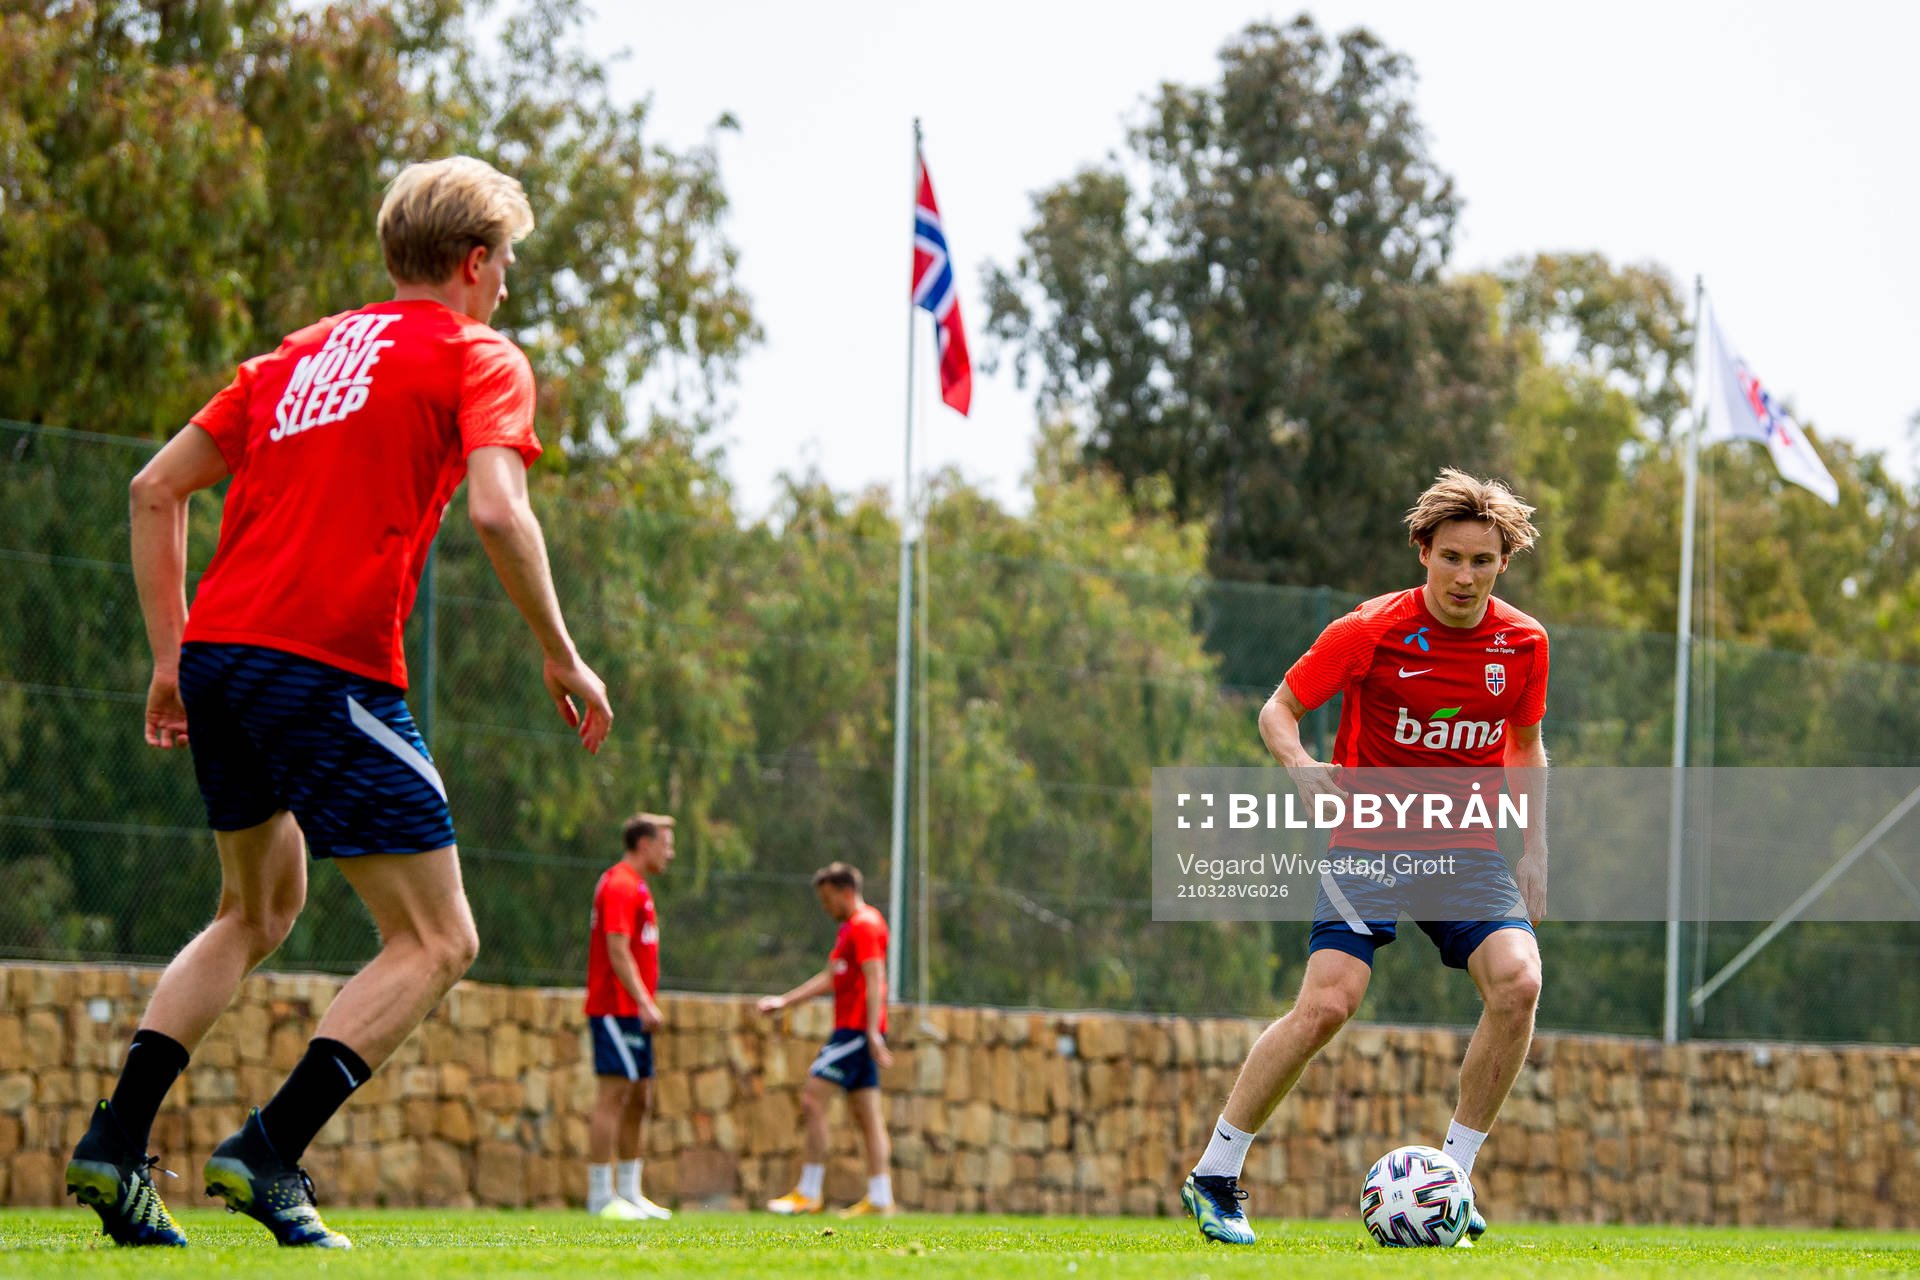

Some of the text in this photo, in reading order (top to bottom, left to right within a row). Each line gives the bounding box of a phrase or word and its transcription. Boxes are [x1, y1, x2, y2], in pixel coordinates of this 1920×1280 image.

[322, 313, 403, 351] EAT
[283, 340, 396, 398] MOVE
[269, 378, 369, 442] SLEEP
[1394, 708, 1506, 749] bama
